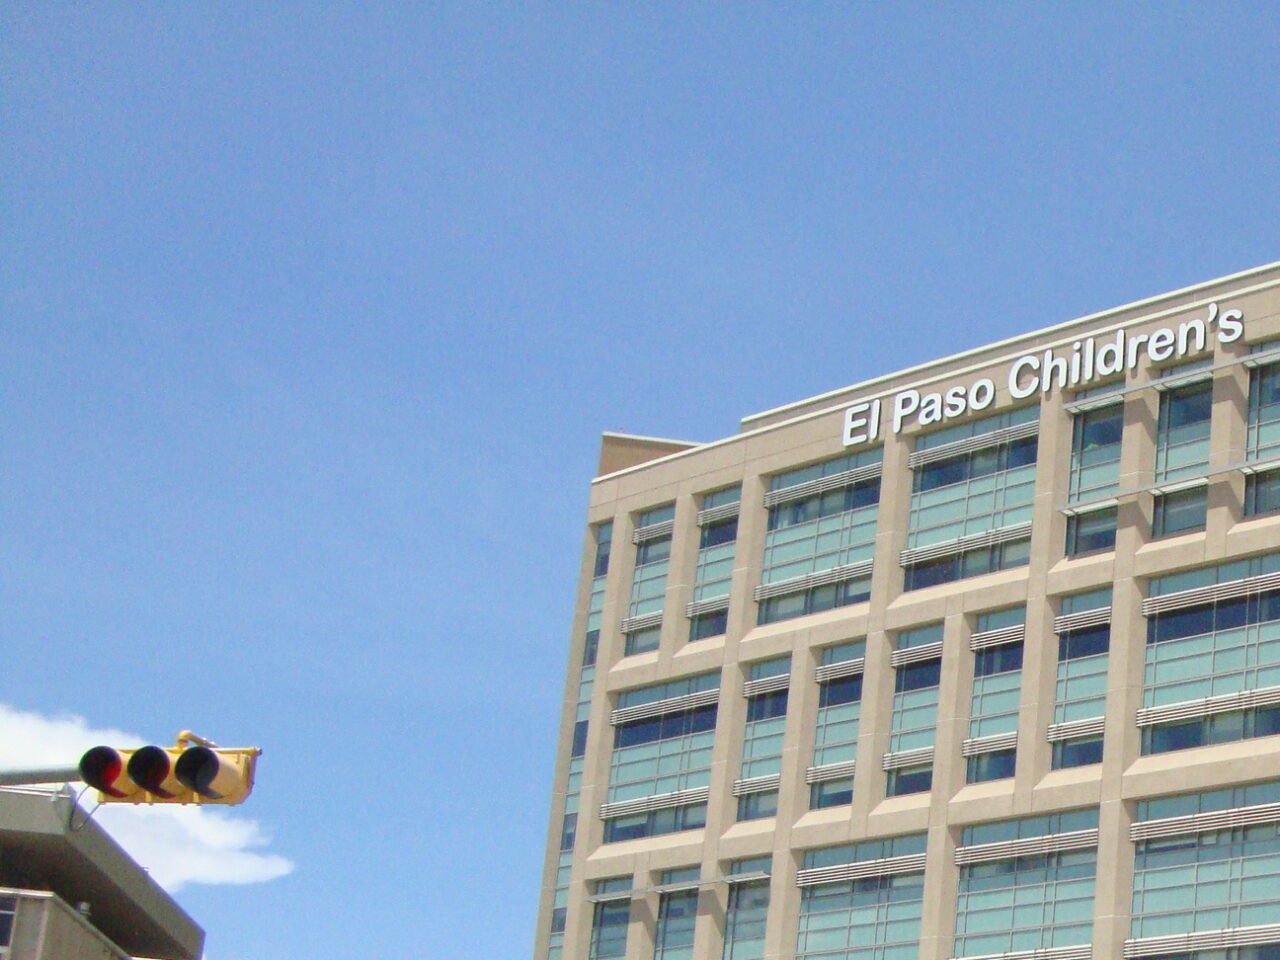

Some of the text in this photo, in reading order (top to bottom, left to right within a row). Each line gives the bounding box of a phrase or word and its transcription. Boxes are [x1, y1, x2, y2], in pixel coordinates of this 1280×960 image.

[842, 302, 1245, 447] El Paso Children's
